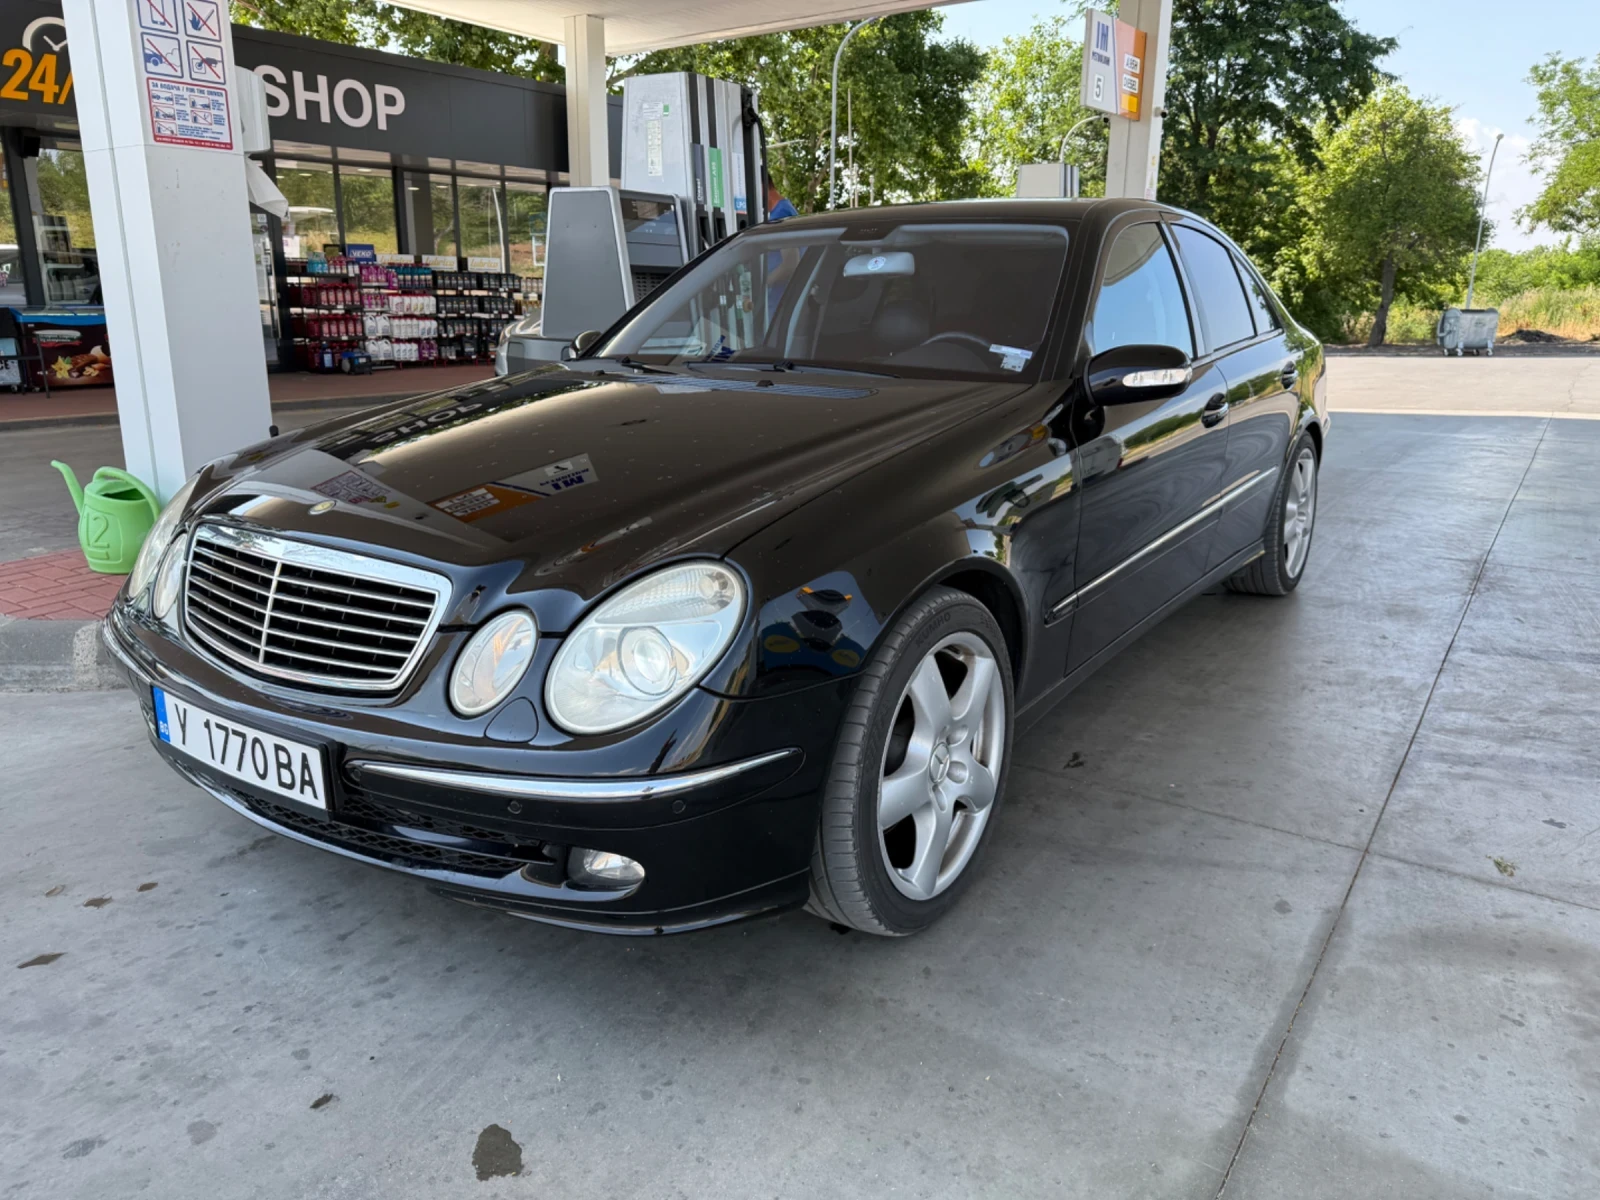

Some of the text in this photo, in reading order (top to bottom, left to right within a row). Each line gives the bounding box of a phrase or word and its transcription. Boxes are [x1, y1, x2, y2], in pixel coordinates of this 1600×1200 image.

[0, 48, 74, 105] 24/
[253, 64, 406, 131] SHOP
[1095, 78, 1102, 97] 5
[914, 611, 952, 648] KUMHO
[174, 703, 187, 745] Y
